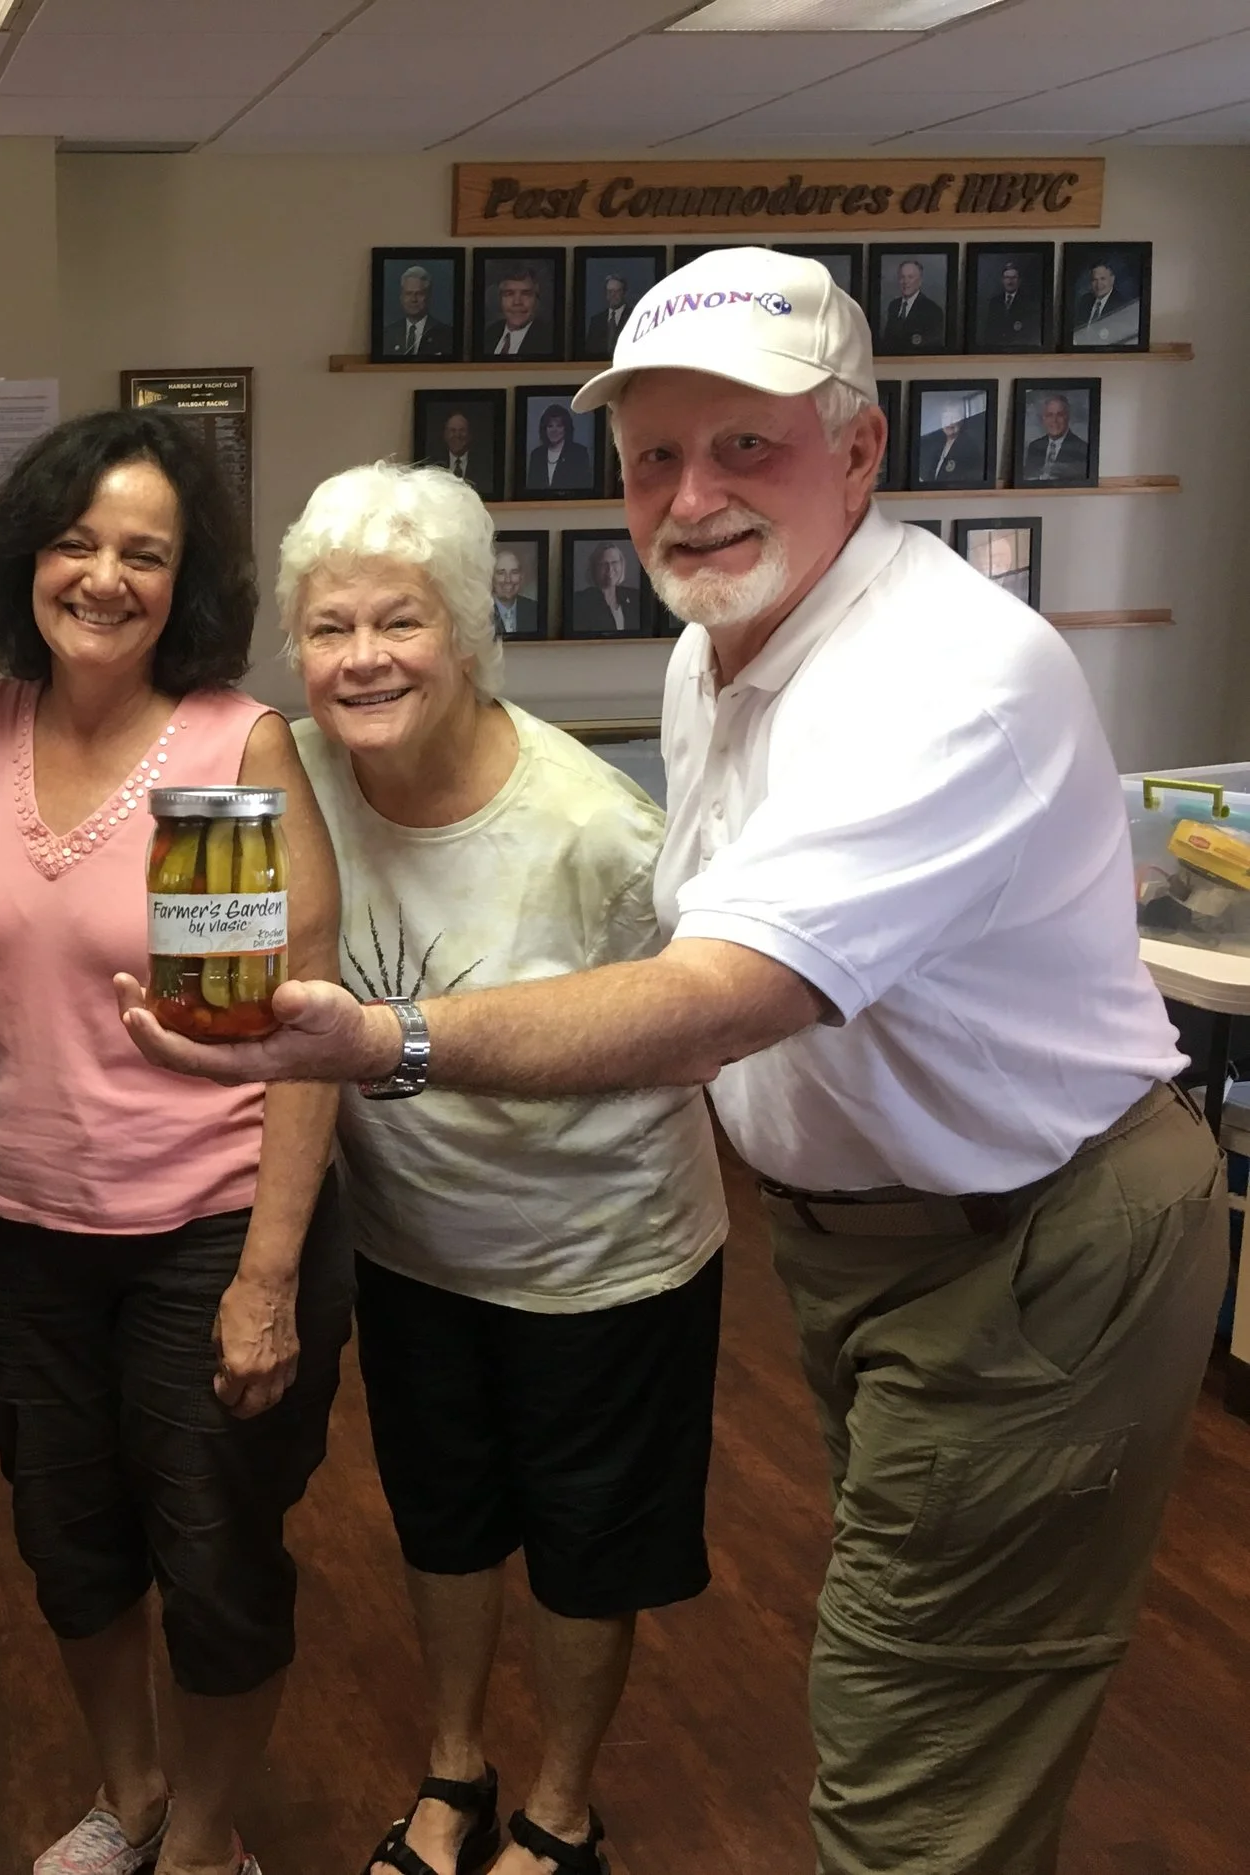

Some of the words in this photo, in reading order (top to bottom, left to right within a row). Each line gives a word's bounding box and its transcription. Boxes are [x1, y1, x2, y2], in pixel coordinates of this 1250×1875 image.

[484, 177, 589, 219] Past
[599, 174, 894, 219] Commodores
[901, 172, 955, 215] of
[955, 172, 1079, 215] HBYC
[632, 291, 754, 343] CANNON
[153, 900, 222, 920] Farmer's
[225, 898, 282, 919] Garden
[188, 919, 205, 936] by
